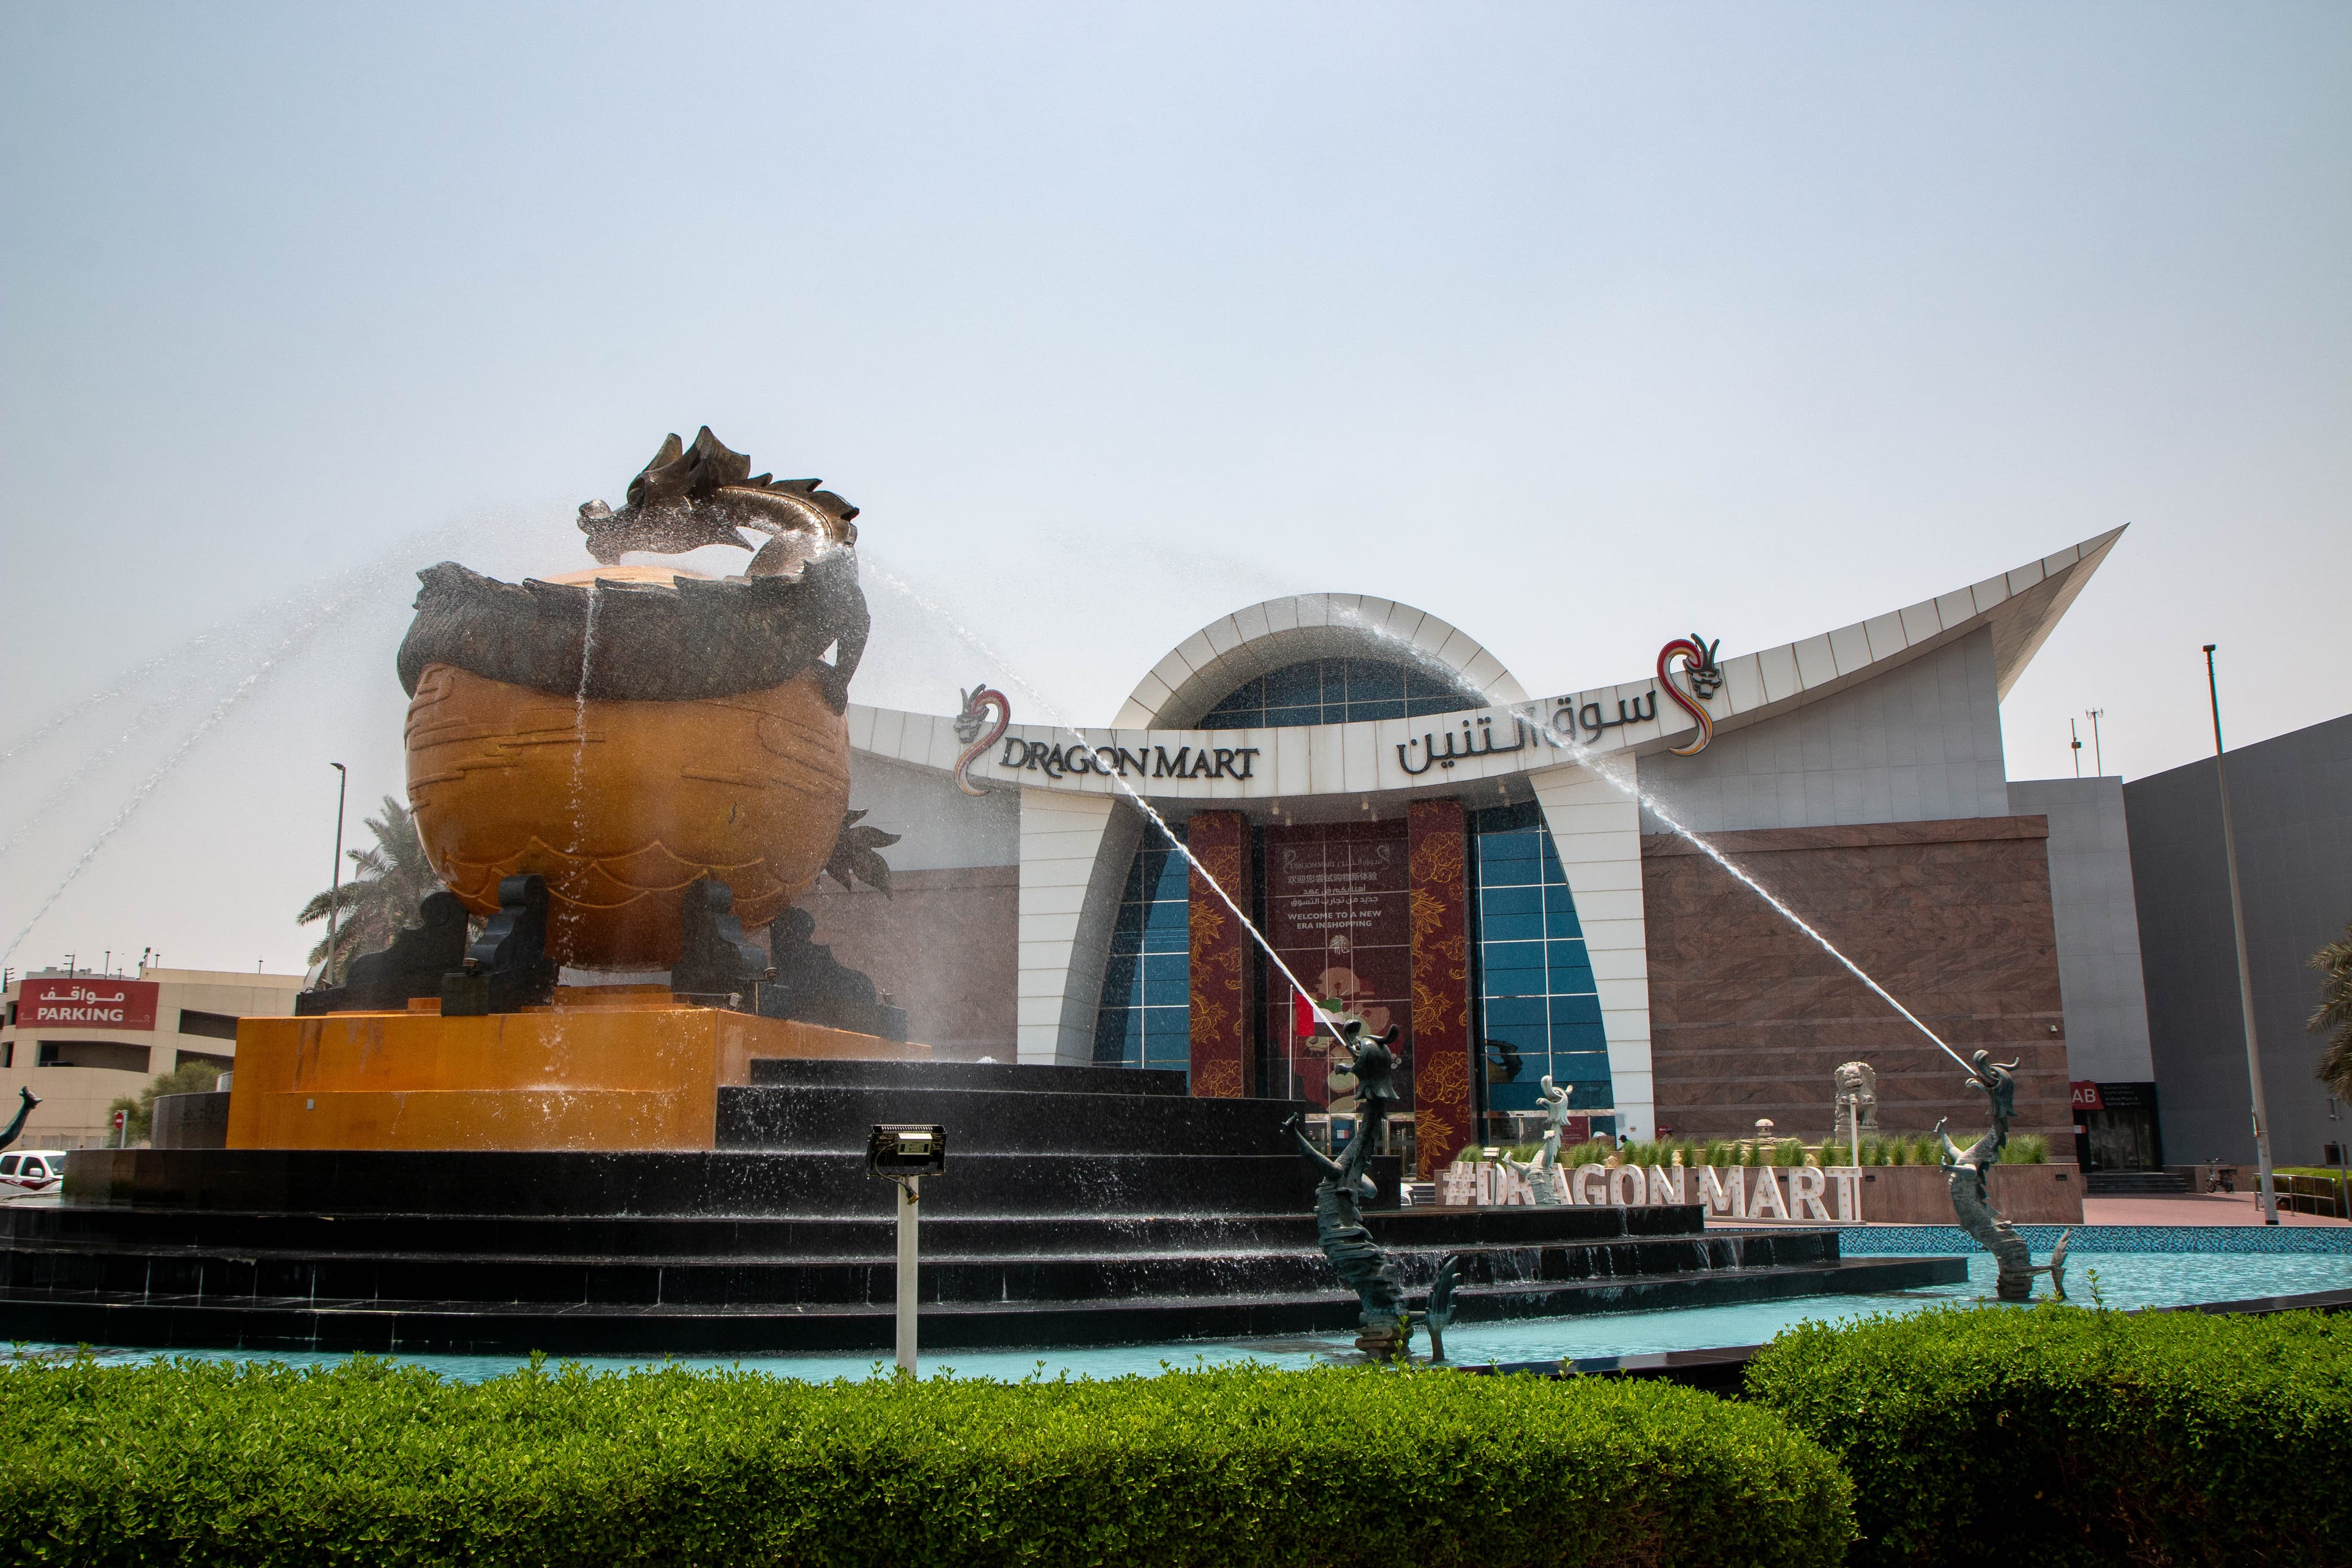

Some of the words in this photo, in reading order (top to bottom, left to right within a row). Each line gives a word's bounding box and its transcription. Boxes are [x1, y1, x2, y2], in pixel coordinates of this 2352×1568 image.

[1543, 690, 1656, 748] سوق
[1396, 707, 1538, 775] التنين
[999, 737, 1150, 779] DRAGON
[1152, 745, 1260, 780] MART
[1291, 898, 1319, 907] التسوق
[1327, 920, 1372, 929] SHOPPING
[40, 986, 125, 1005] مواقف
[37, 1008, 124, 1022] PARKING
[1699, 1165, 1862, 1221] MART
